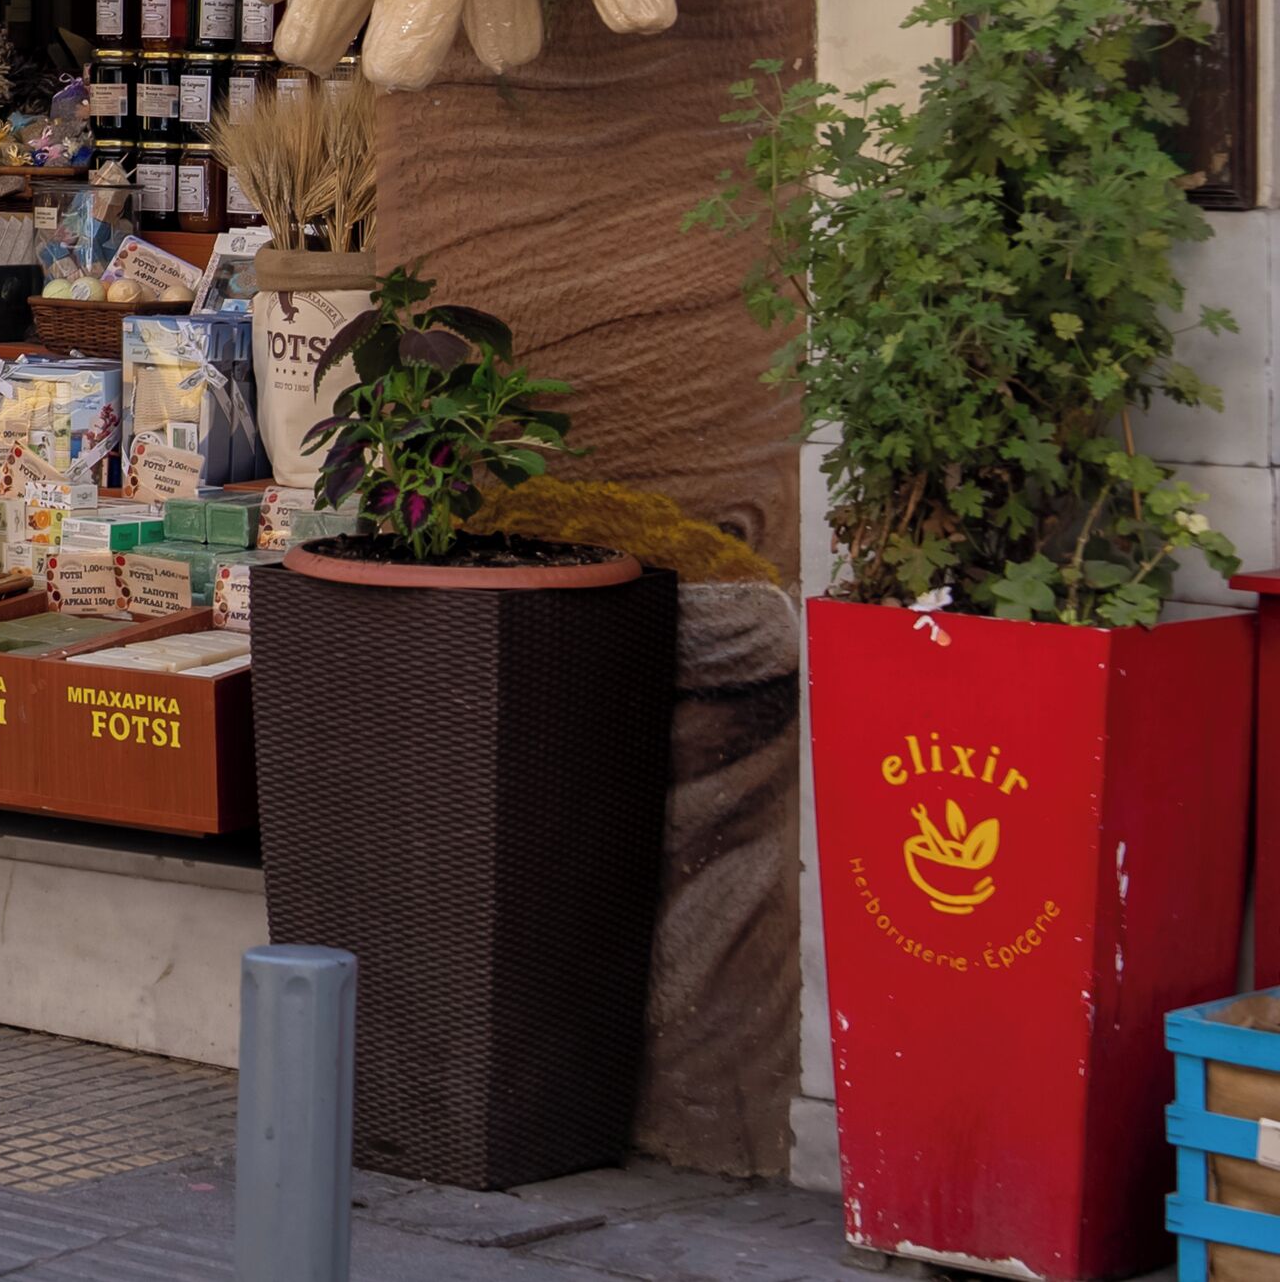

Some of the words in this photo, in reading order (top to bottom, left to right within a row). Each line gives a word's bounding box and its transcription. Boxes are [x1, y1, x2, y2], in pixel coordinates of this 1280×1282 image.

[132, 256, 158, 274] FOTSI
[143, 459, 166, 472] FOTSI
[60, 571, 83, 580] FOTSI
[129, 570, 154, 582] FOTSI
[72, 586, 106, 594] ΣΑΠΟΥΝΙ
[142, 586, 179, 600] ΣΑΠΟΥΝΙ
[64, 598, 92, 606] ΑΡΚΑΔΙ
[133, 597, 163, 608] ΑΡΚΑΔΙ
[67, 686, 181, 715] ΜΠΑΧΑΡΙΚΑ
[91, 710, 181, 748] FOTSI
[881, 731, 1029, 797] elixir
